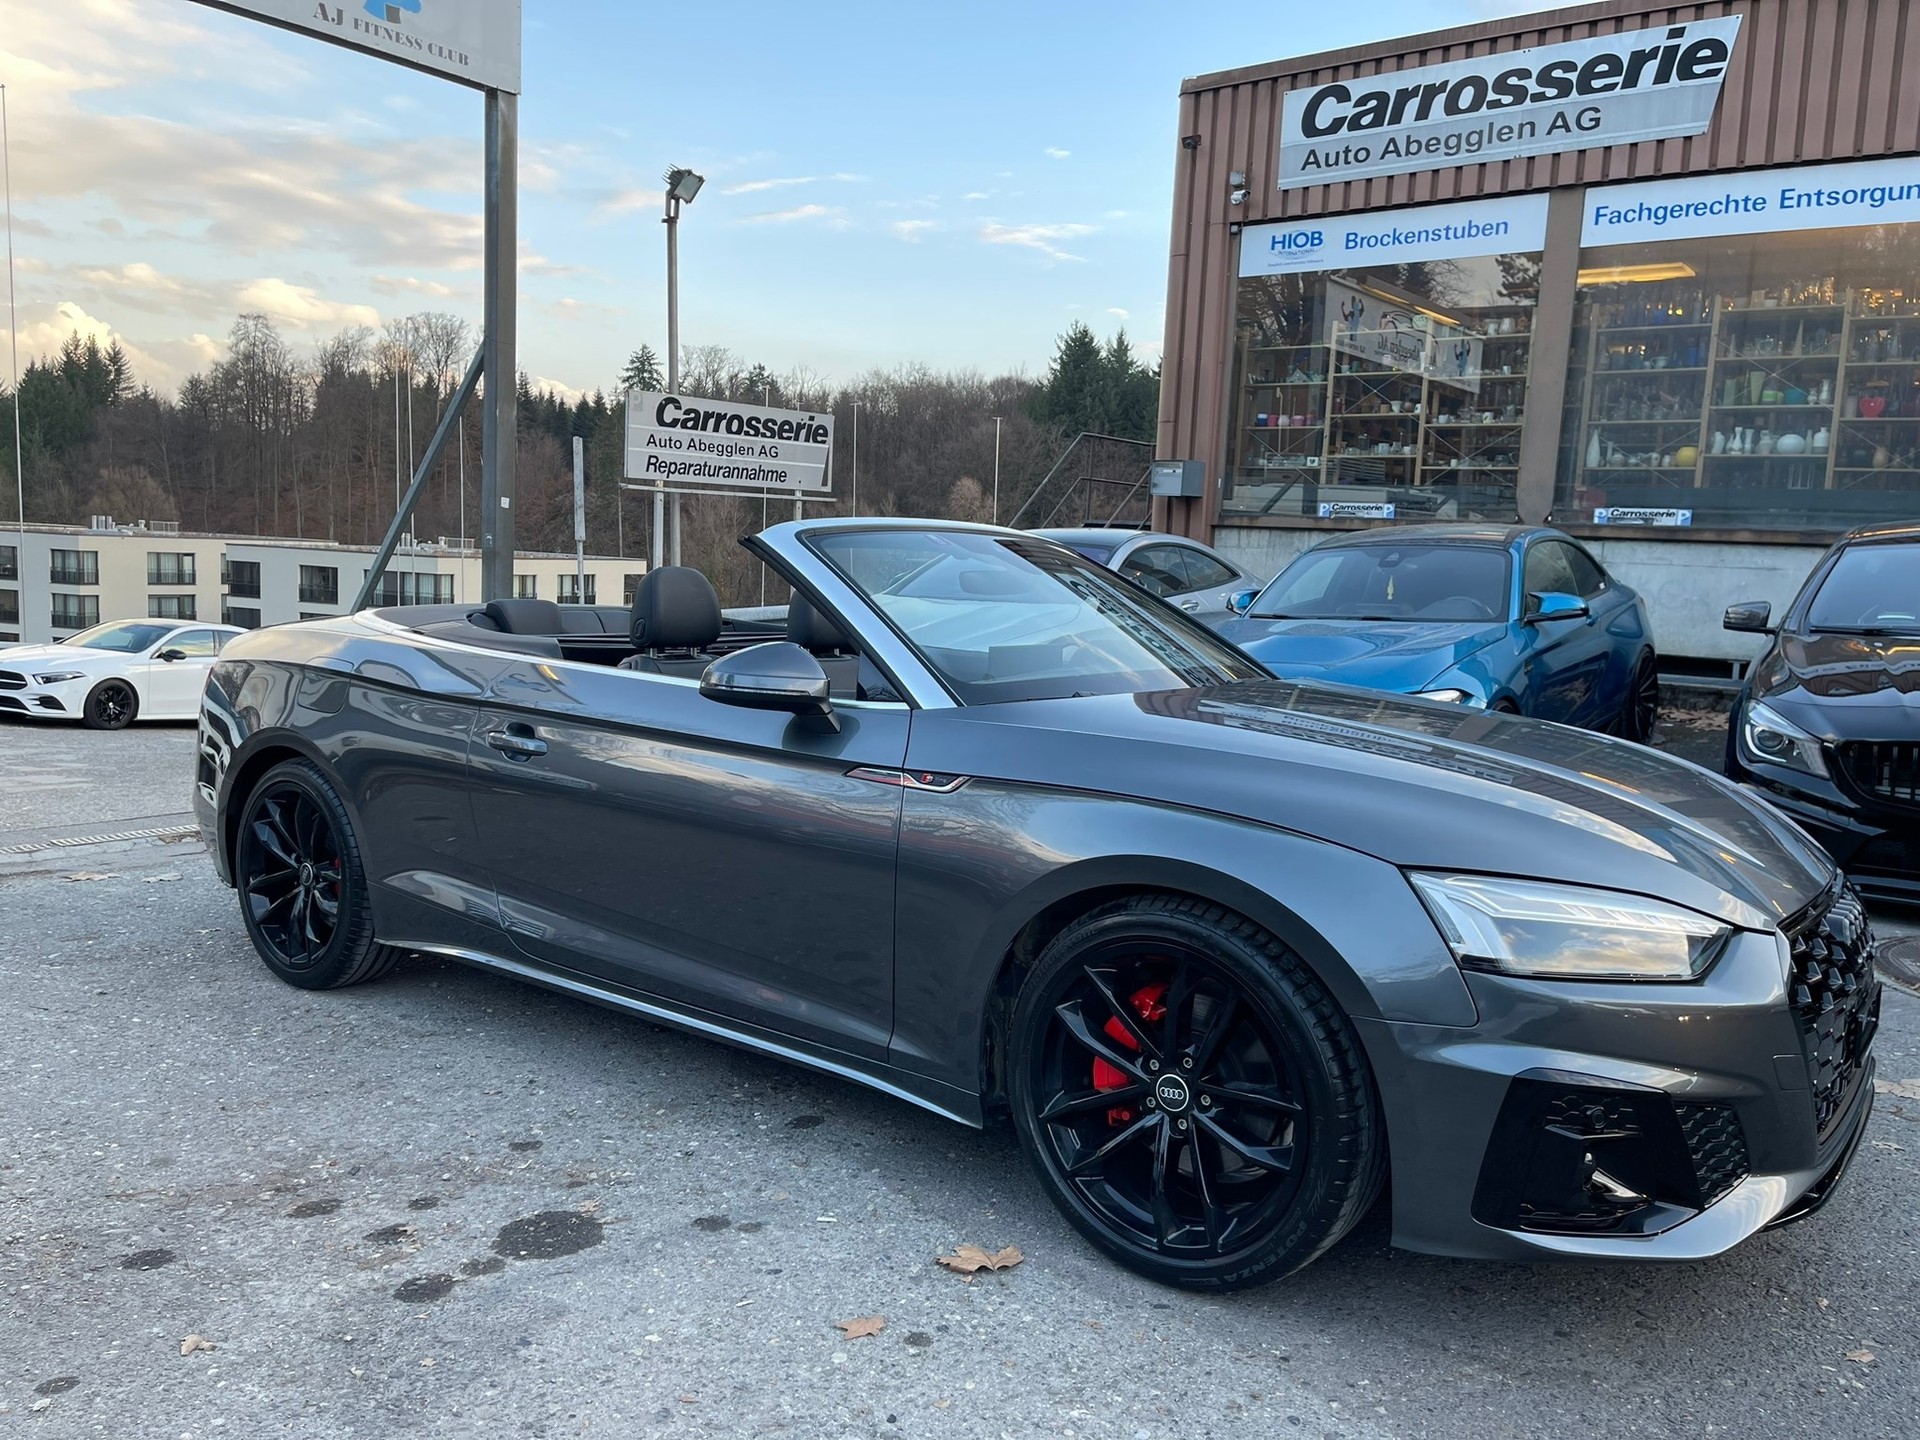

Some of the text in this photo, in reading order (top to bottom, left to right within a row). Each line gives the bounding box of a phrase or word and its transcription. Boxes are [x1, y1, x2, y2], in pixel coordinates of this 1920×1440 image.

[312, 2, 469, 66] AJ FITNESS CLUB
[1300, 26, 1729, 139] Carrosserie
[1300, 107, 1602, 171] Auto Abegglen AG
[1594, 193, 1767, 225] Fachgerechte
[1271, 219, 1509, 250] HIOB Brockenstuben
[656, 396, 829, 444] Carrosserie
[646, 434, 779, 458] Auto Abegglen AG
[645, 454, 788, 483] Reparaturannahme
[1332, 503, 1383, 511] Carrosserie
[1611, 509, 1676, 518] Carrosserie
[1222, 1219, 1308, 1283] POTENZA
